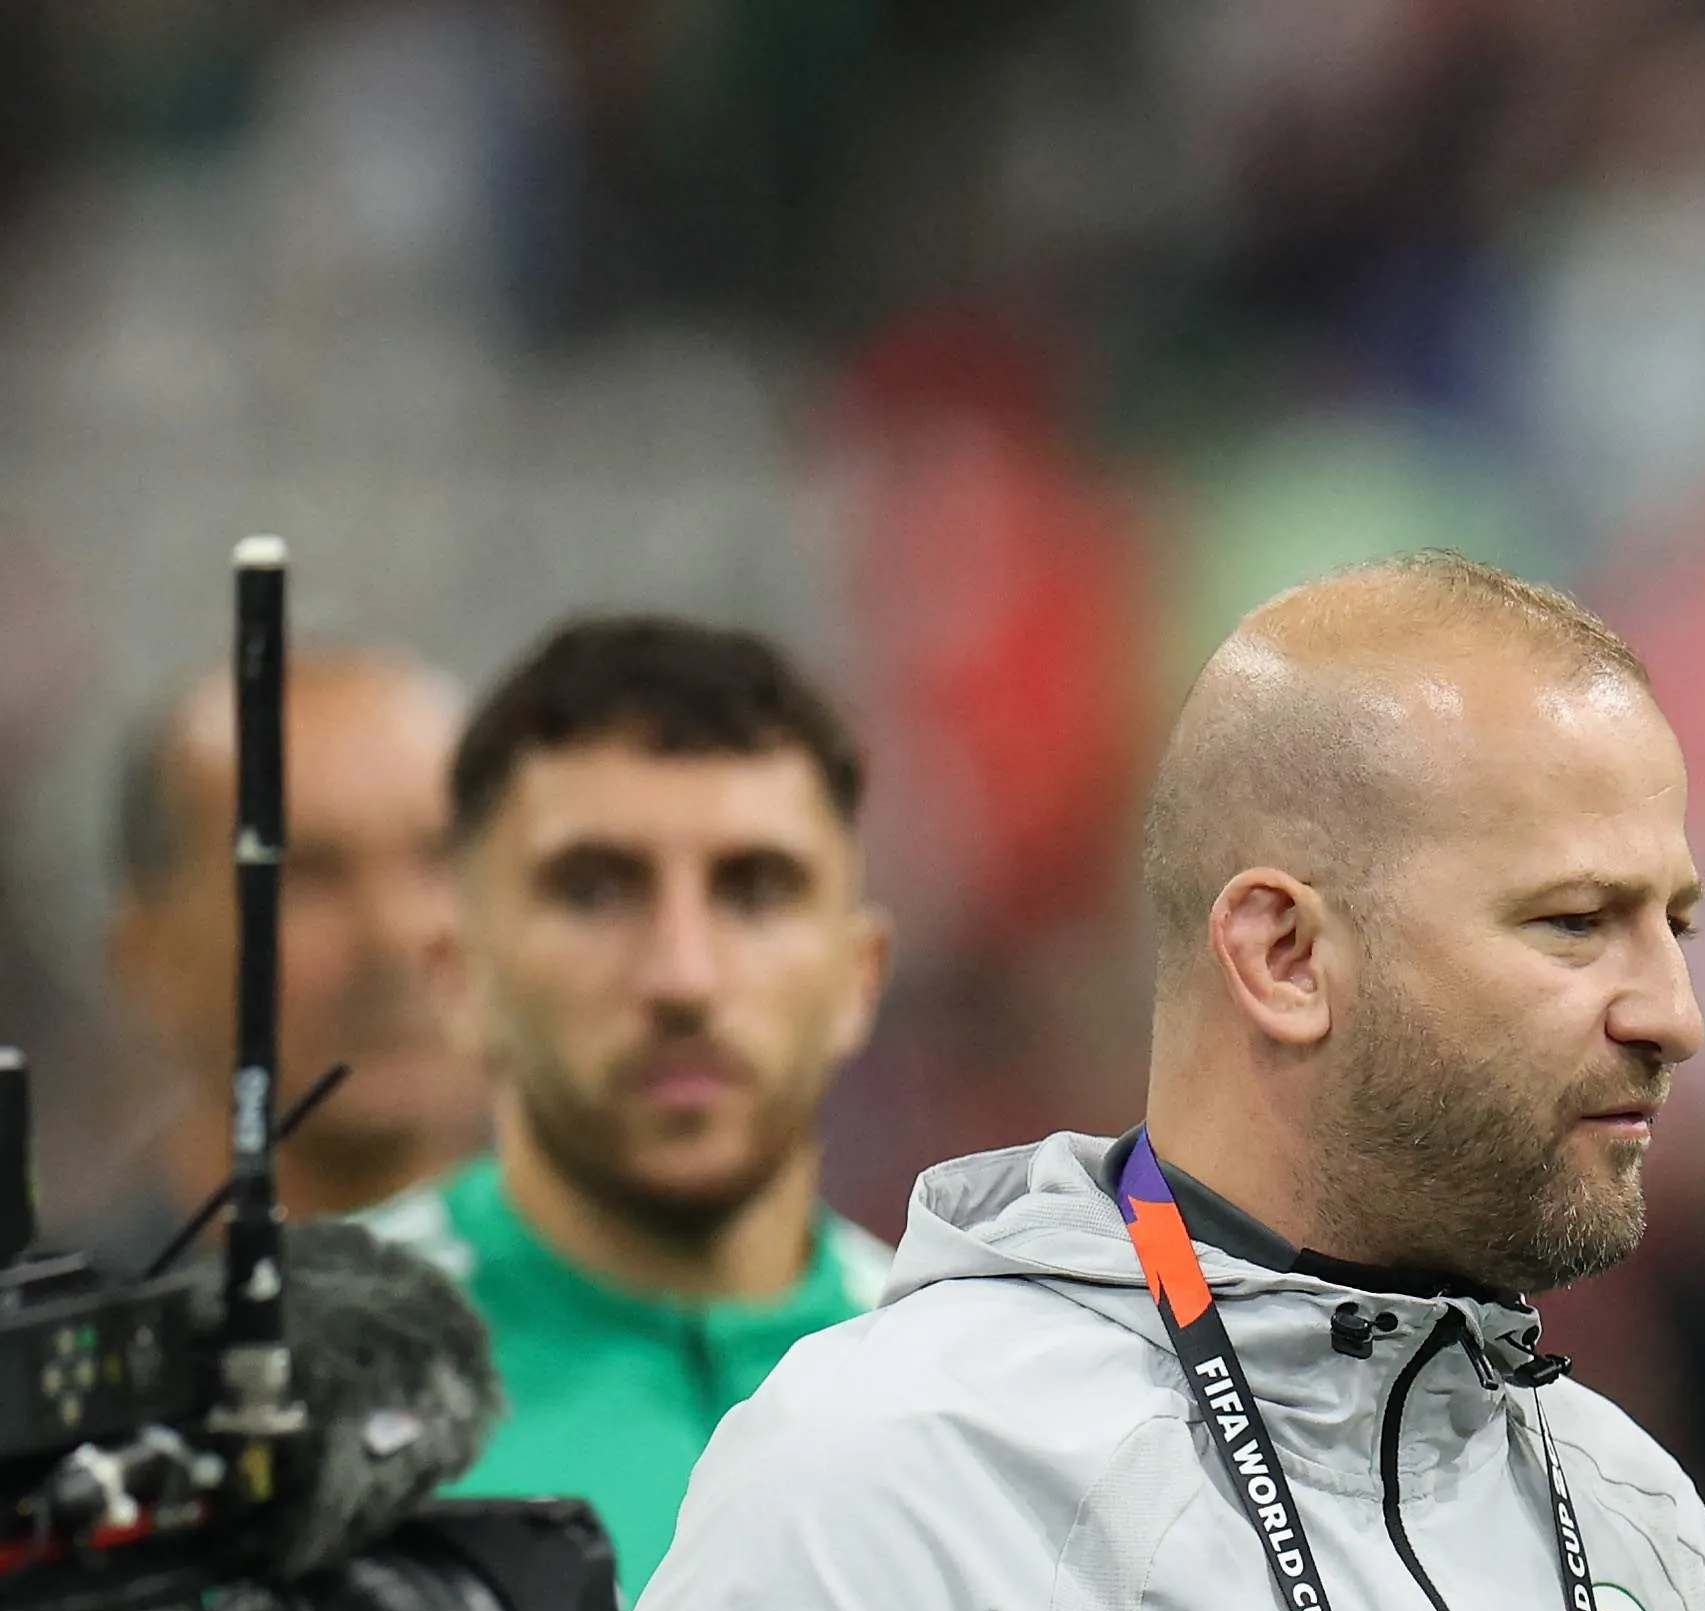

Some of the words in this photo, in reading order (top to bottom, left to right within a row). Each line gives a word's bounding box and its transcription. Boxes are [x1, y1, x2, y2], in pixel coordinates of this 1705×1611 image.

[1195, 1355, 1250, 1443] FIFA
[1232, 1438, 1304, 1577] WORLD
[1558, 1502, 1585, 1577] CUP
